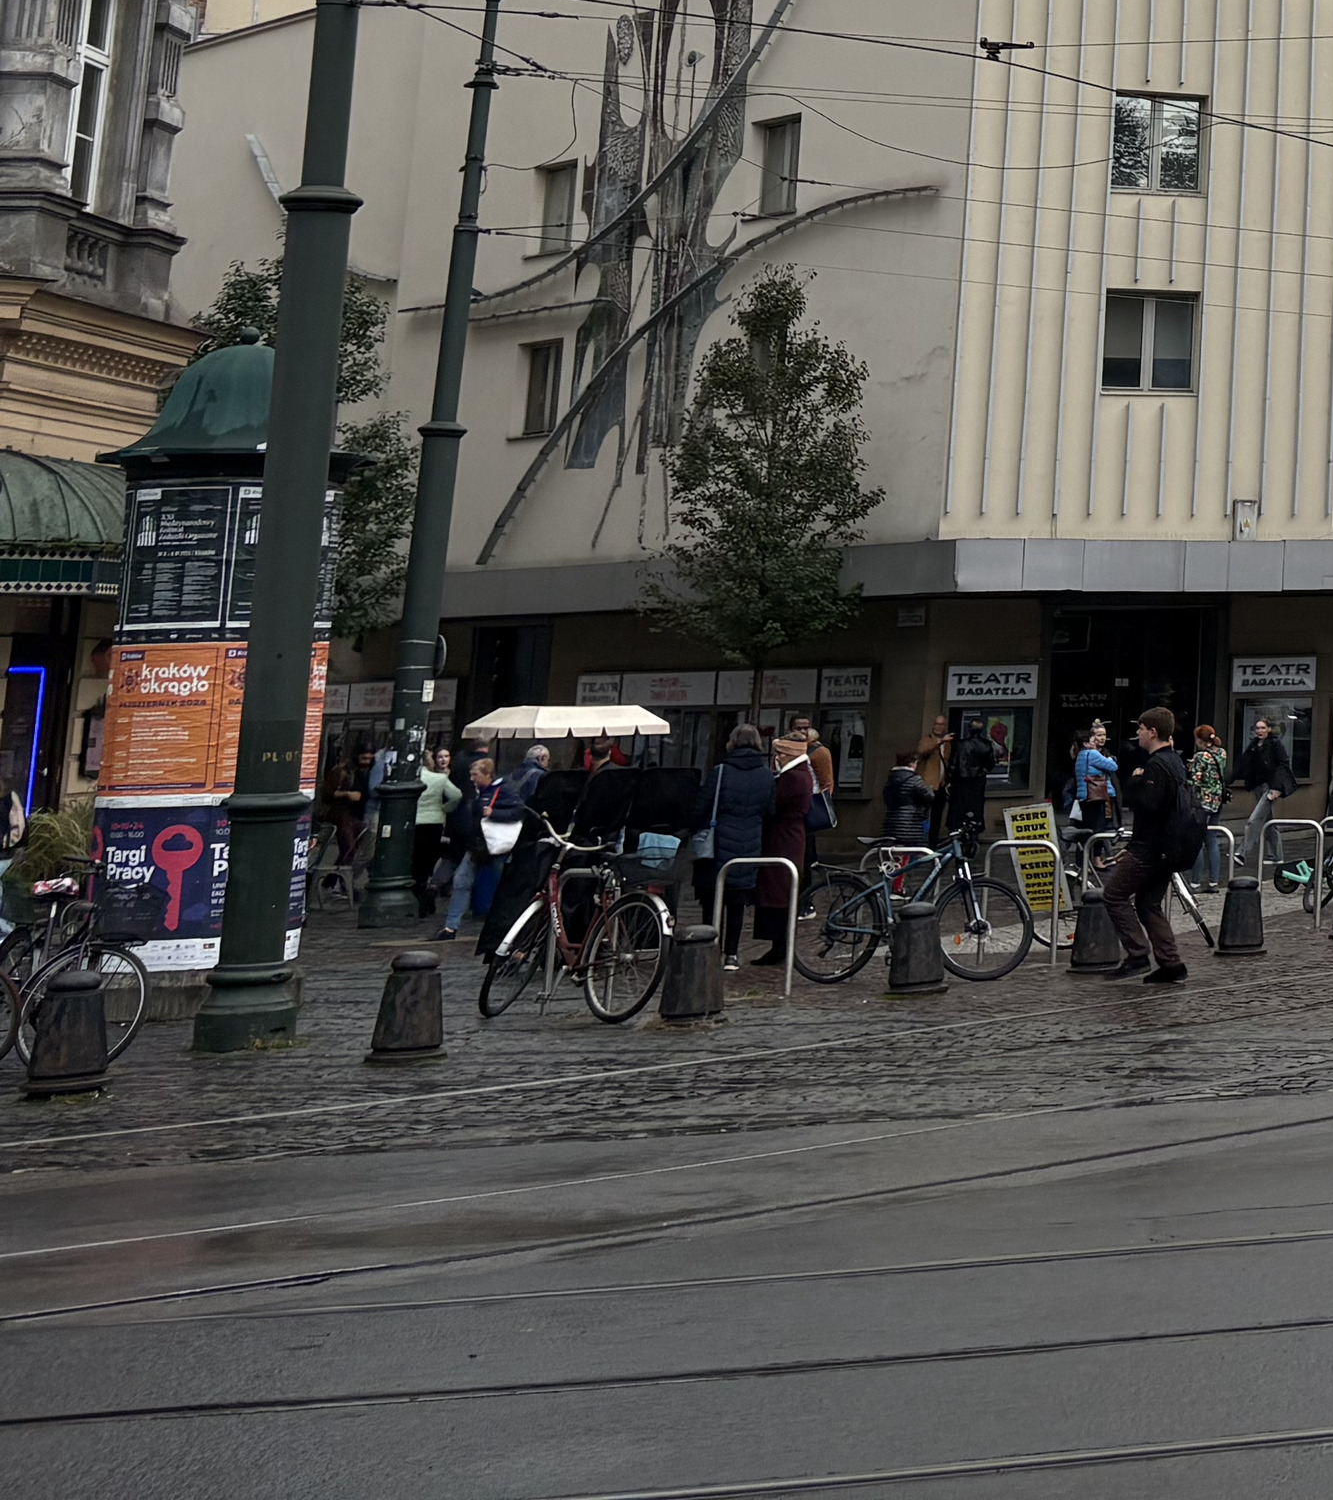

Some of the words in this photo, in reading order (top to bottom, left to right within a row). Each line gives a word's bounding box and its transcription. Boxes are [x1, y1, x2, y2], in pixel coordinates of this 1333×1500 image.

[141, 663, 210, 679] kraków
[1237, 663, 1311, 675] TEATR
[824, 674, 868, 687] TEATR
[952, 672, 1032, 685] TEATR
[1241, 677, 1306, 687] BAGATELA
[581, 681, 618, 693] TEATR
[956, 687, 1026, 696] BAGATELA
[1011, 811, 1047, 822] KSERO
[1015, 822, 1046, 833] DRUK
[106, 845, 146, 866] Targi
[106, 864, 155, 883] Pracy
